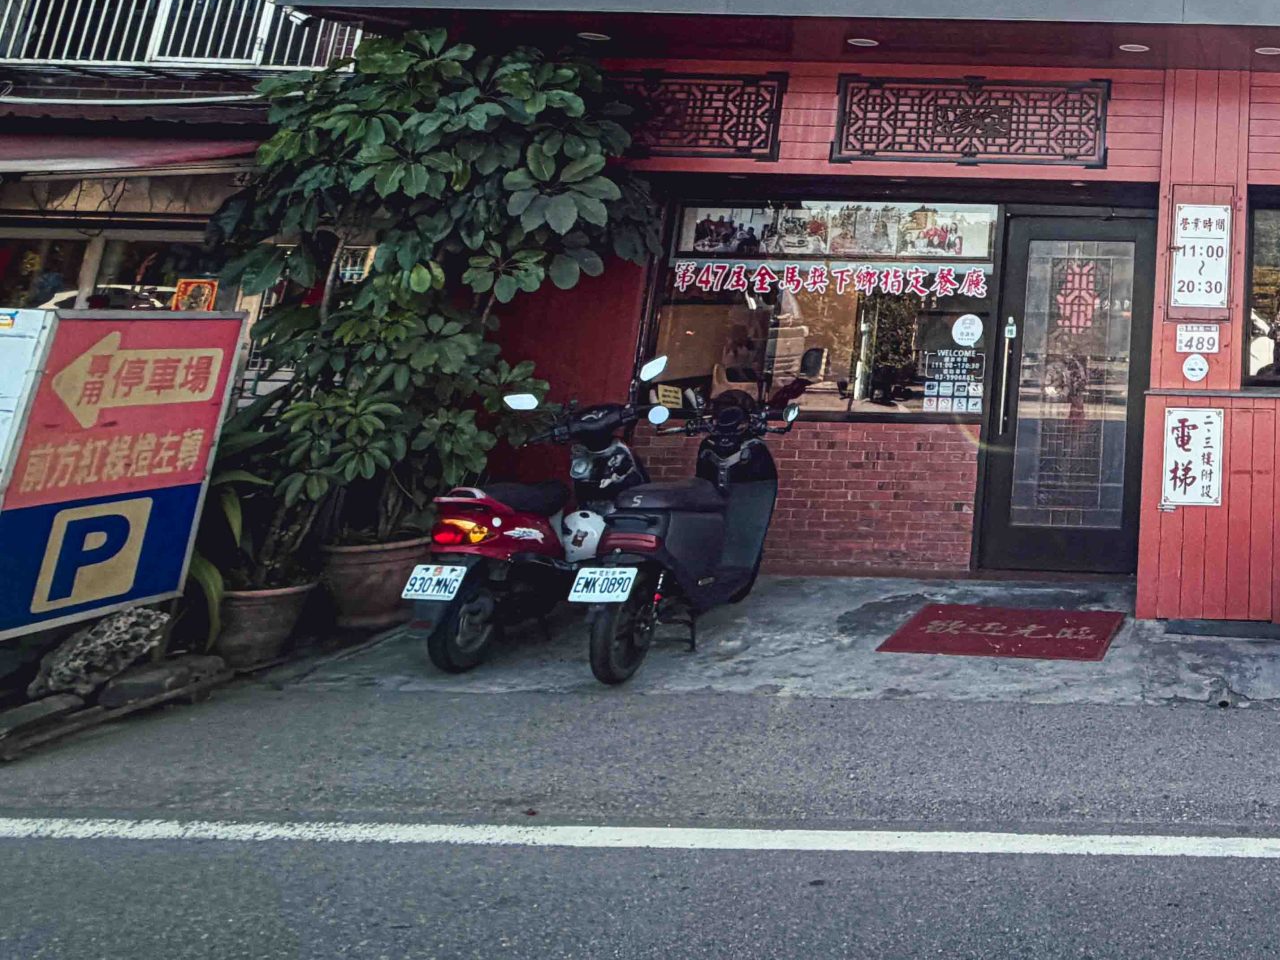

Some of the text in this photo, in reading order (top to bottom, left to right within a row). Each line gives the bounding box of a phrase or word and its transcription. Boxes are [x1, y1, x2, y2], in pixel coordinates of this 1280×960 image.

[1180, 217, 1226, 233] 營業時間
[1182, 244, 1224, 258] 11:00
[1177, 280, 1223, 294] 20:30
[1184, 336, 1216, 351] 489
[937, 349, 976, 358] WELCOME
[112, 356, 214, 399] 停車場
[20, 429, 205, 493] 前方紅綠燈左轉
[1169, 418, 1199, 496] 電梯
[46, 514, 131, 602] P
[573, 576, 632, 594] EMK-0890
